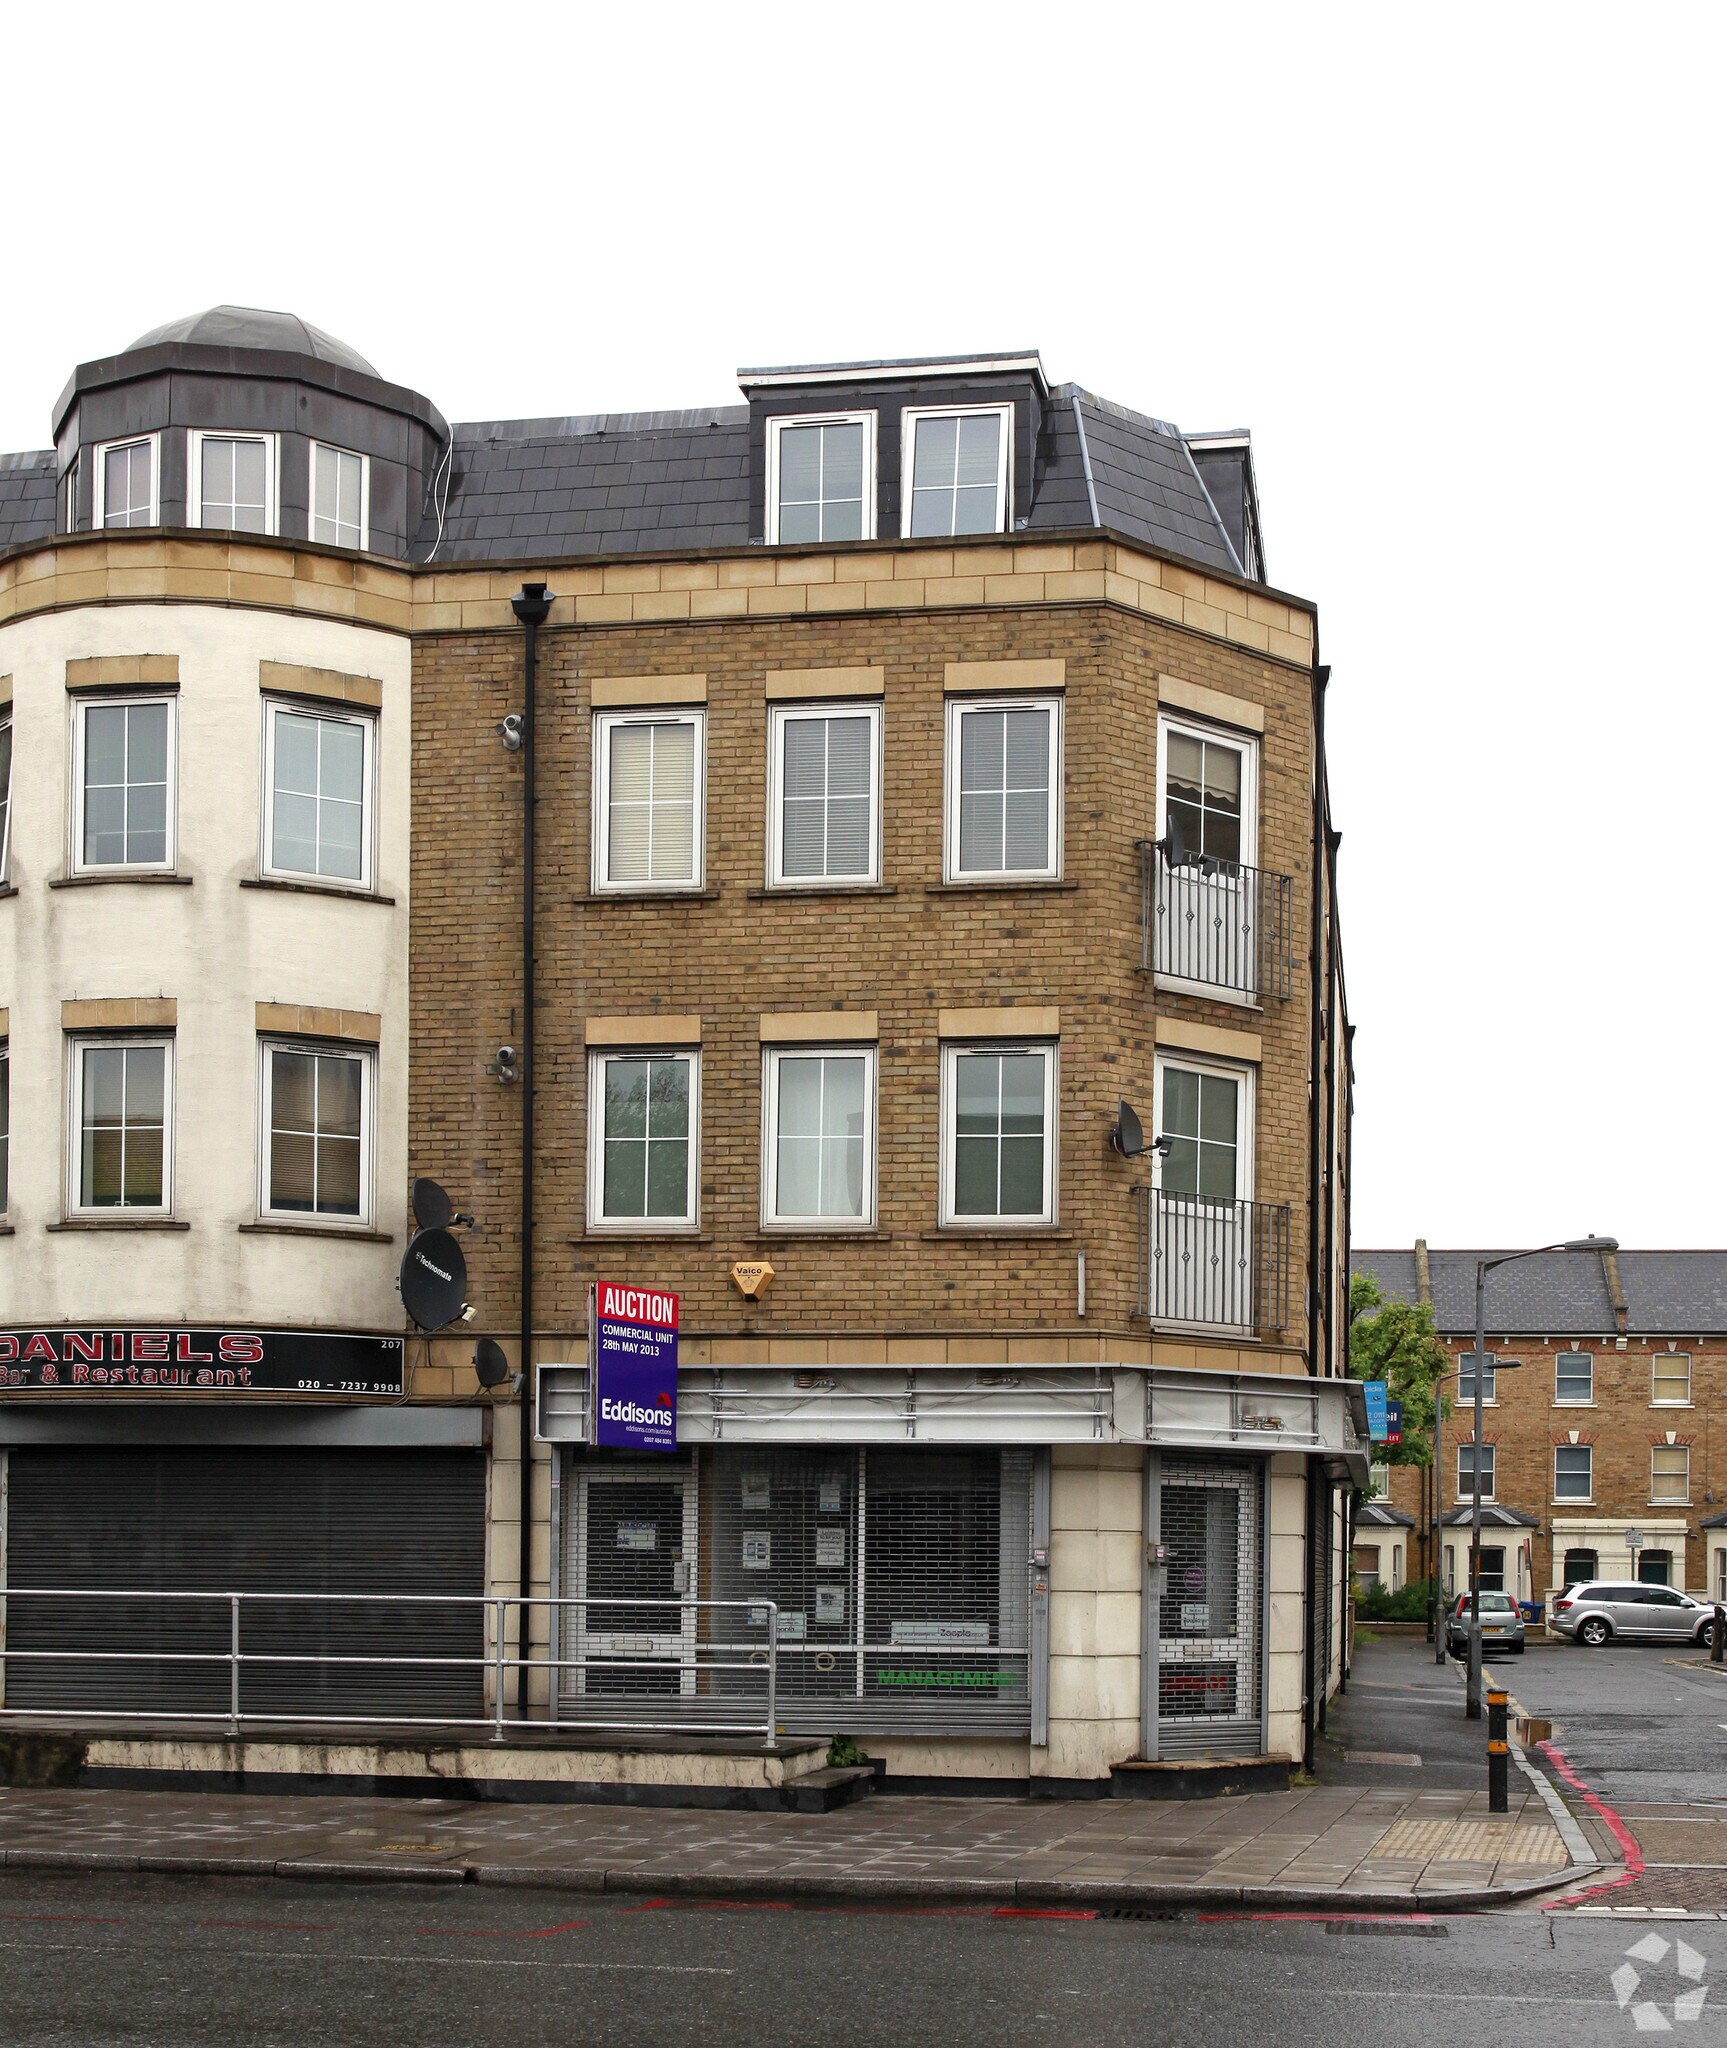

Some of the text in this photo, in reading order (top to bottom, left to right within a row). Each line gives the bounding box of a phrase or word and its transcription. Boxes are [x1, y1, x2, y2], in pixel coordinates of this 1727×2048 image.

[420, 1254, 452, 1281] Technomate
[603, 1287, 673, 1324] AUCTION
[602, 1324, 674, 1344] COMMERCIAL UNIT
[381, 1340, 401, 1349] 207
[602, 1339, 660, 1356] 28th MAY 2013
[41, 1363, 60, 1385] &
[73, 1363, 252, 1386] Restaurant
[298, 1379, 320, 1389] 020
[340, 1381, 367, 1391] 7237
[373, 1383, 401, 1392] 9908
[601, 1398, 672, 1426] Eddisons
[776, 1626, 795, 1634] oopla
[877, 1670, 1018, 1686] MANAGEMENT
